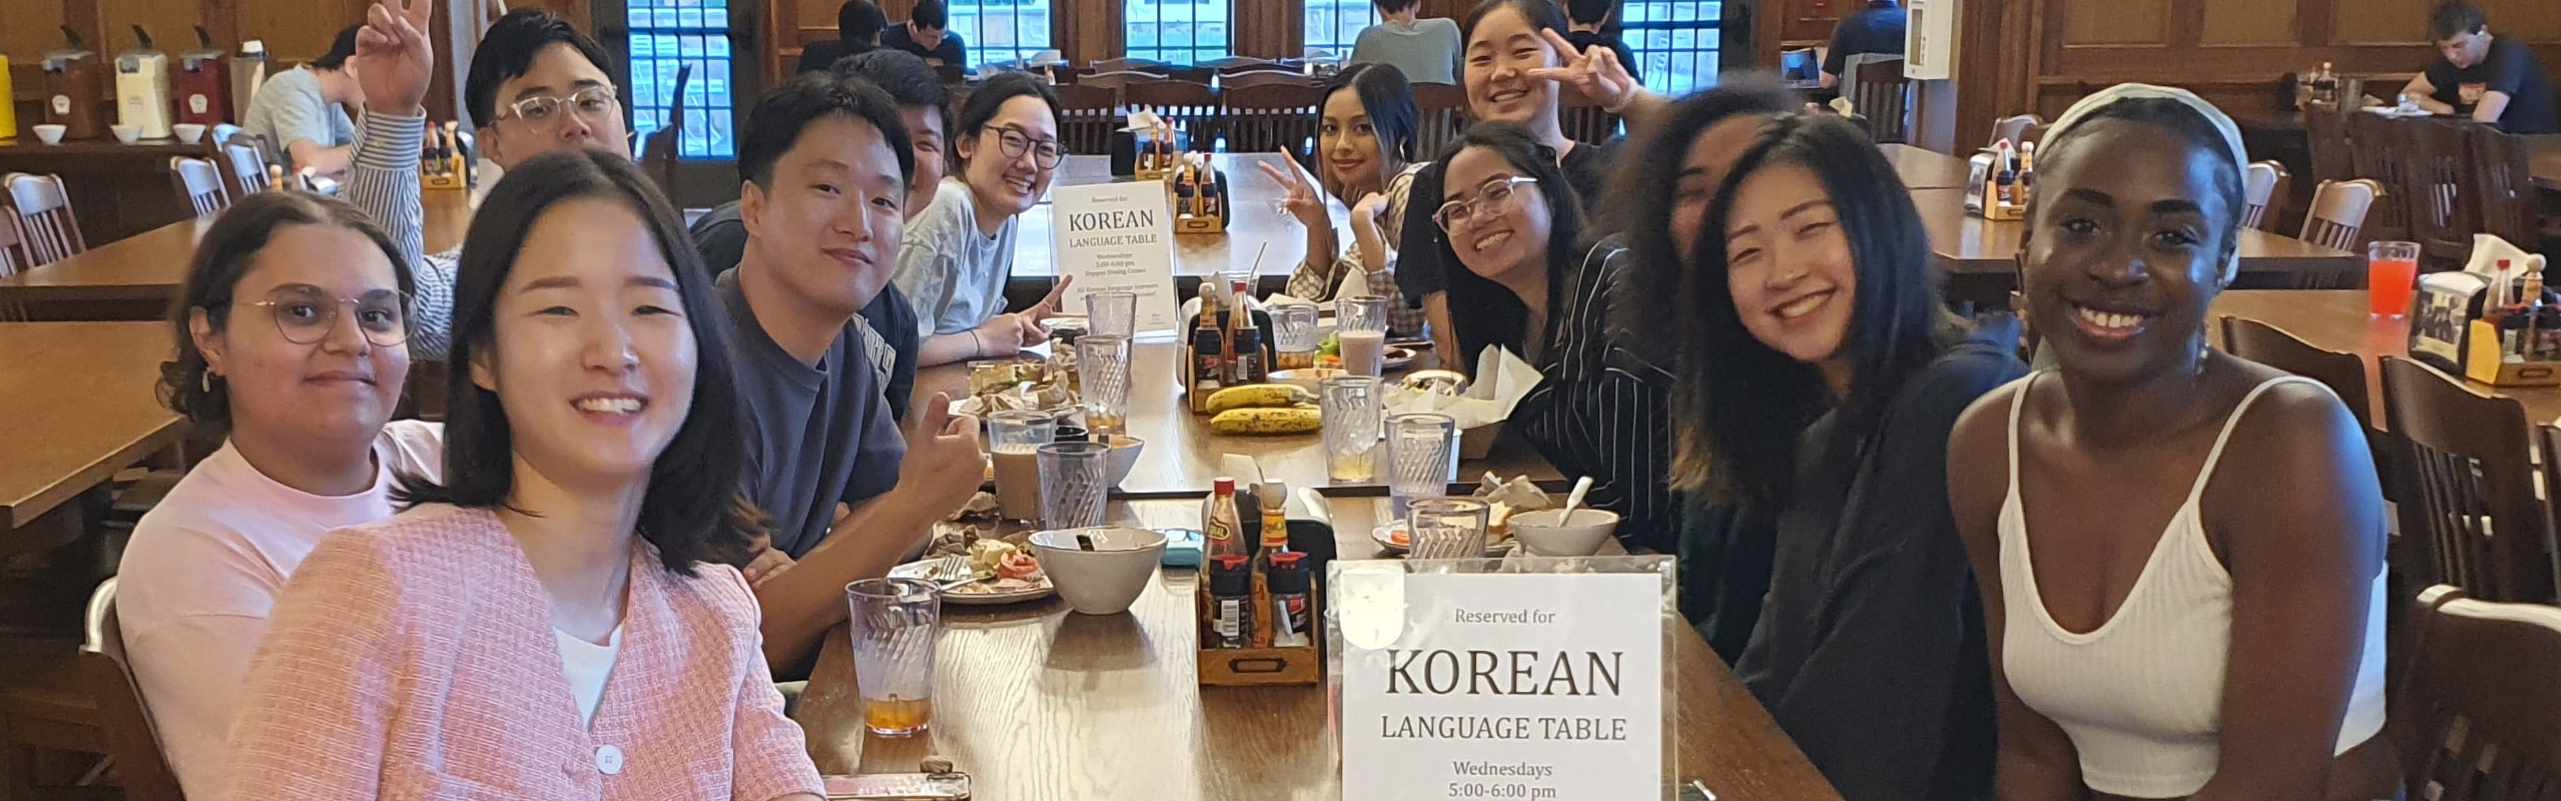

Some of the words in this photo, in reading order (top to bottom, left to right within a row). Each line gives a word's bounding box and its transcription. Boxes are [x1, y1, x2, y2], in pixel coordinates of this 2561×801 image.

[1069, 209, 1154, 232] KOREAN
[1069, 235, 1123, 248] LANGUAGE
[1124, 233, 1157, 246] TABLE
[1454, 608, 1528, 624] Reserved
[1532, 608, 1556, 624] for
[1385, 649, 1624, 697] KOREAN
[1381, 715, 1530, 740] LANGUAGE
[1538, 717, 1627, 741] TABLE
[1453, 761, 1553, 780] Wednesdays
[1448, 782, 1526, 798] 5:00-6:00
[1531, 786, 1556, 801] pm
